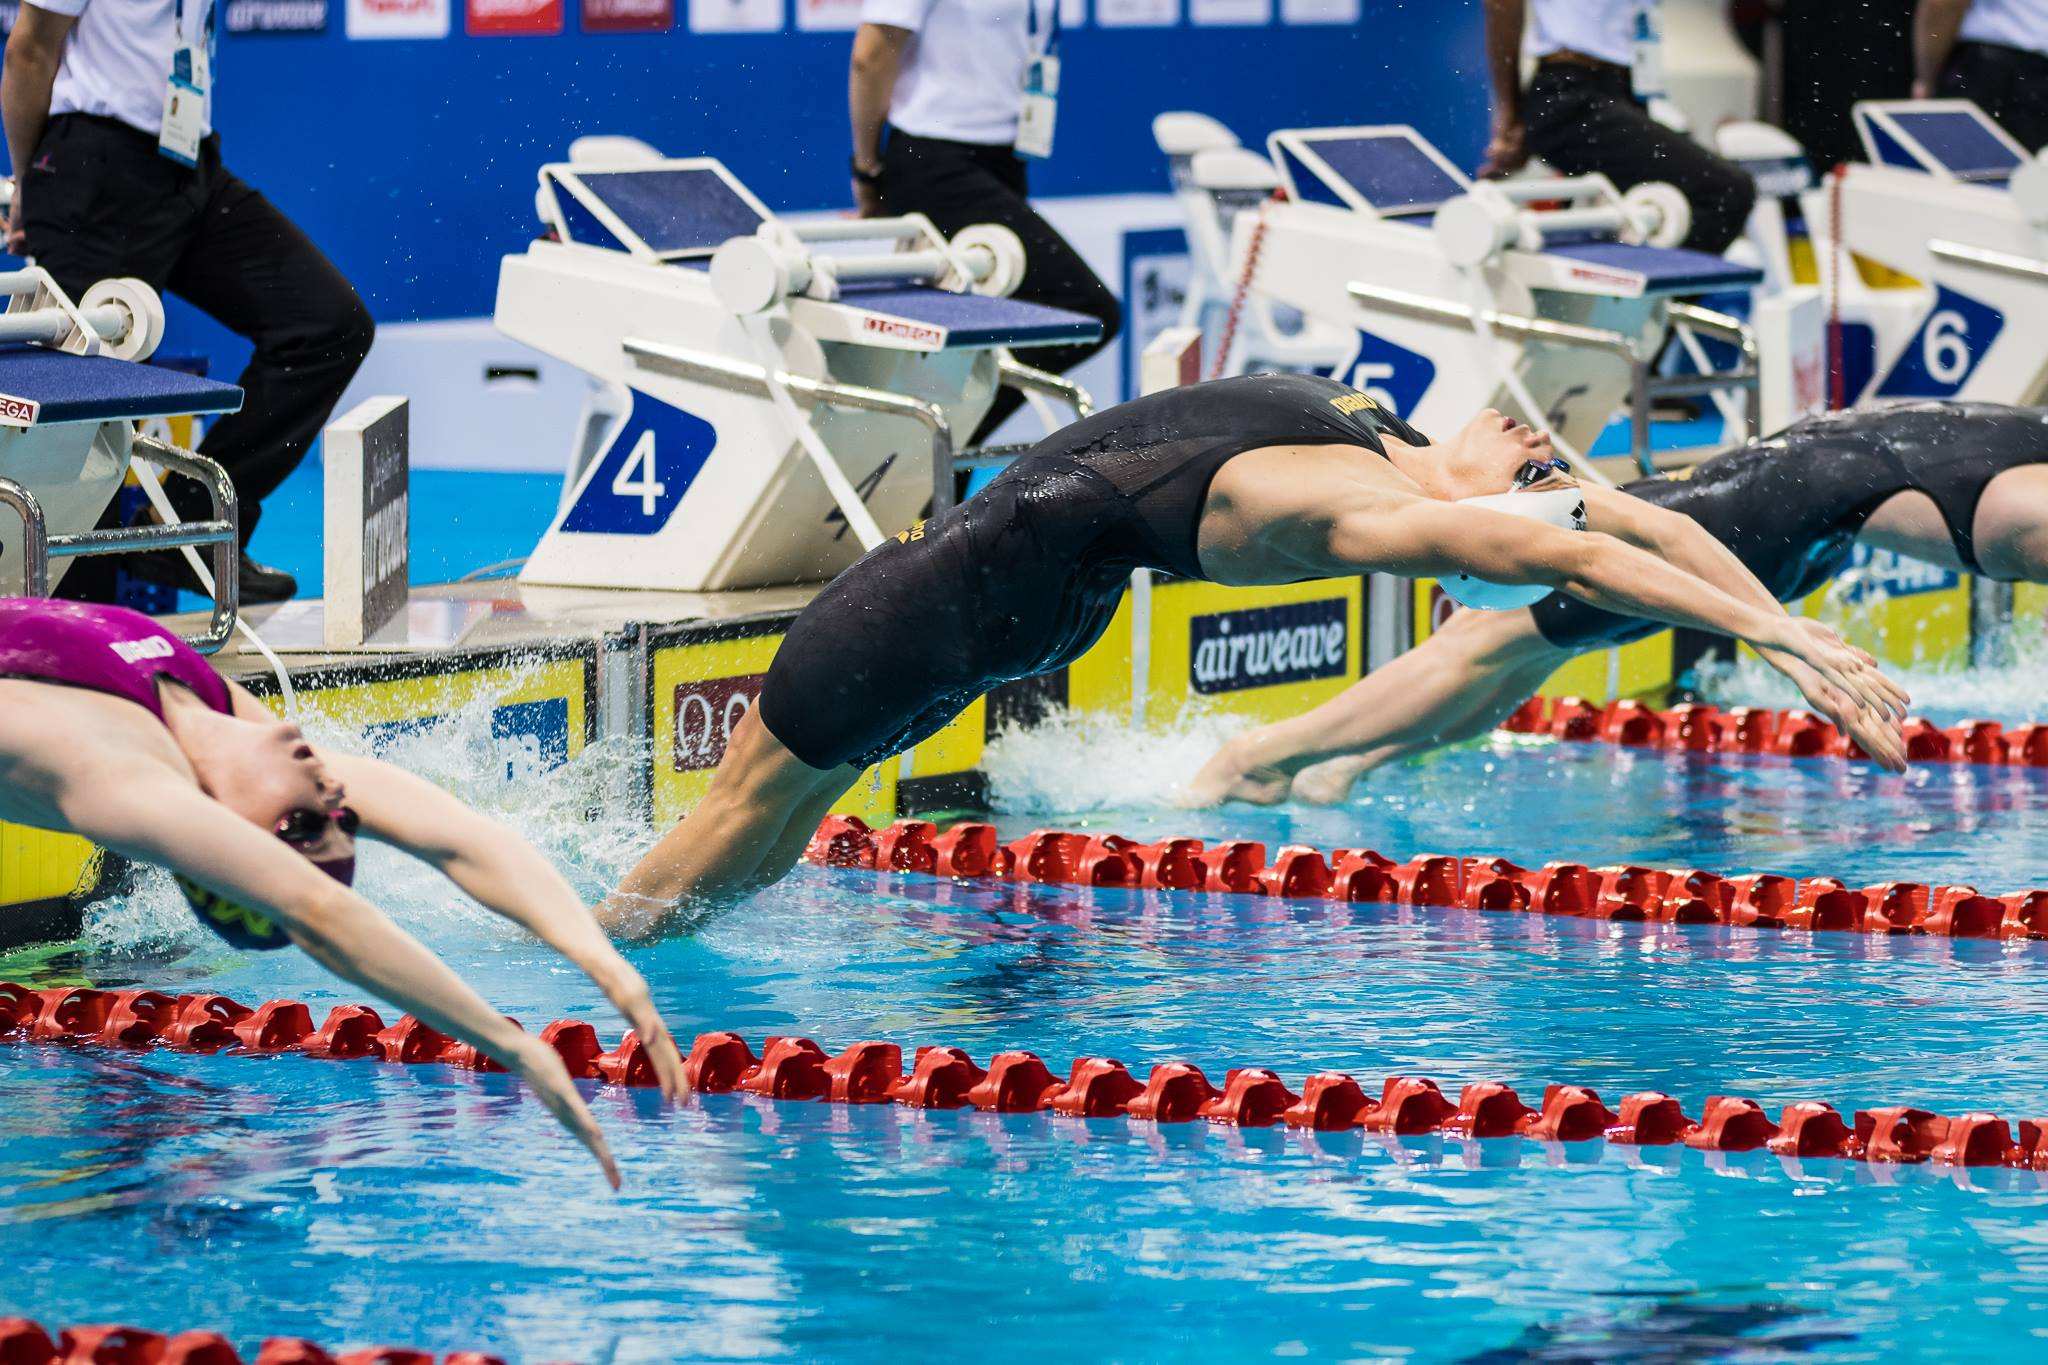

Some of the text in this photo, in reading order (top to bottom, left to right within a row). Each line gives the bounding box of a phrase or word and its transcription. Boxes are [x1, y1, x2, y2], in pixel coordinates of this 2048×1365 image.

[1923, 309, 1970, 385] 6
[1352, 362, 1399, 415] 5
[612, 429, 666, 516] 4
[1195, 617, 1344, 682] airweave
